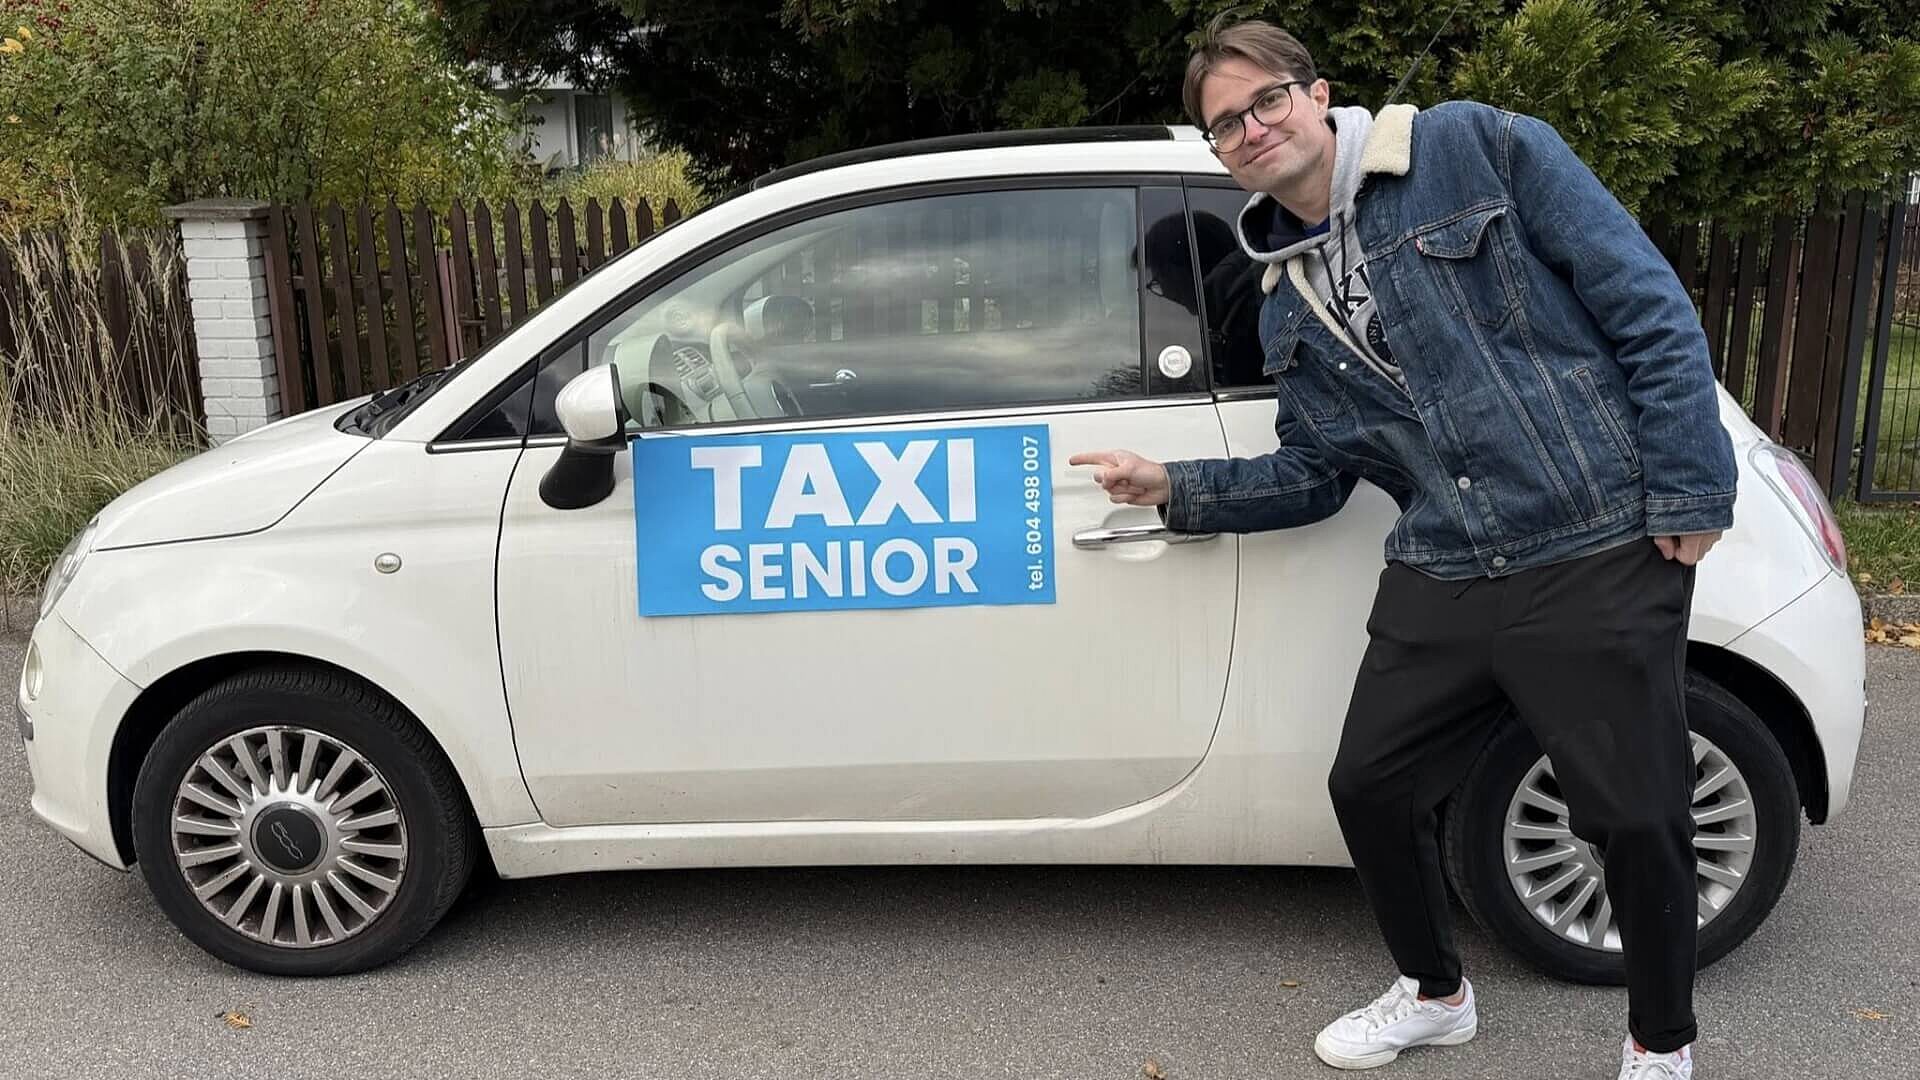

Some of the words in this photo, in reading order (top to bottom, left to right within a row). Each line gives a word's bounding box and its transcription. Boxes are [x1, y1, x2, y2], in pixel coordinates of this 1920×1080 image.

[1022, 436, 1040, 471] 007
[690, 438, 977, 531] TAXI
[1024, 475, 1041, 512] 498
[1026, 516, 1042, 555] 604
[700, 537, 980, 601] SENIOR
[1027, 559, 1044, 591] tel.
